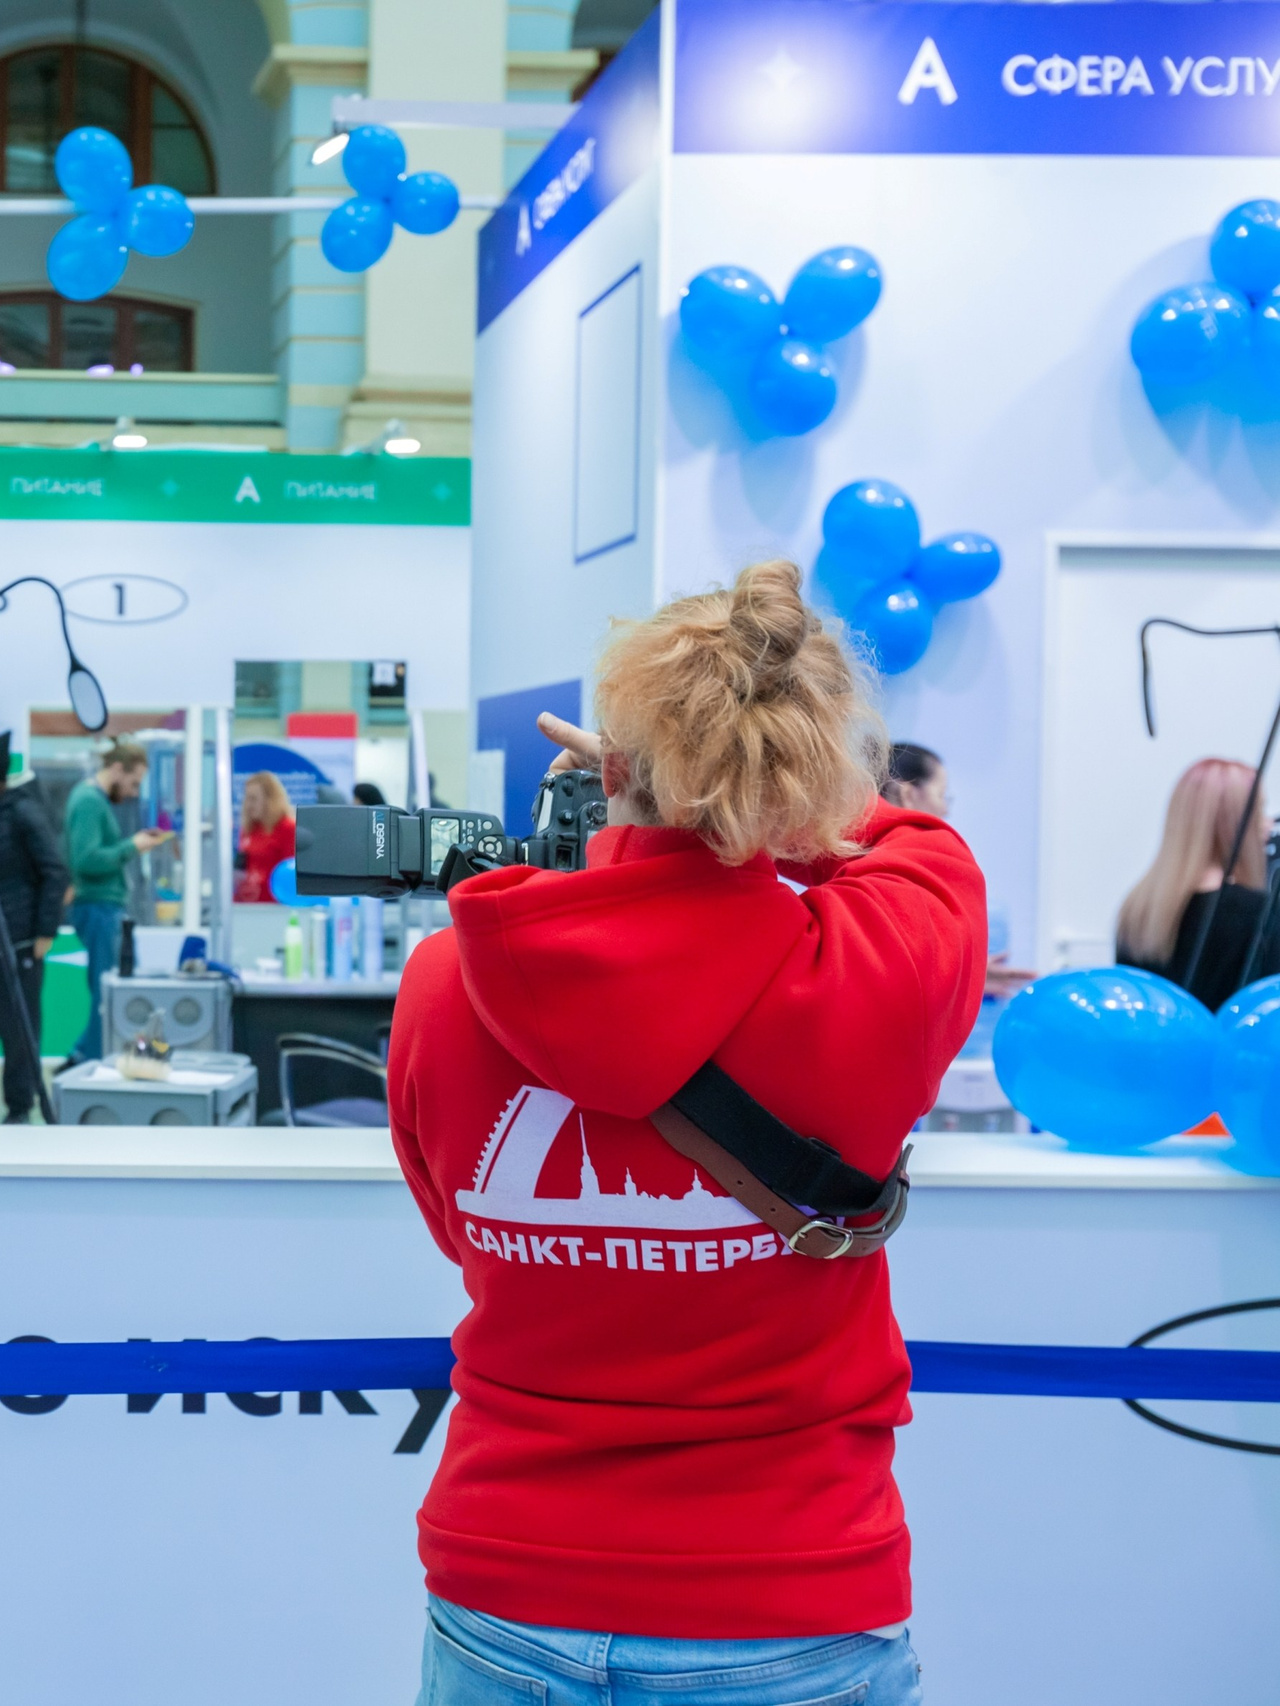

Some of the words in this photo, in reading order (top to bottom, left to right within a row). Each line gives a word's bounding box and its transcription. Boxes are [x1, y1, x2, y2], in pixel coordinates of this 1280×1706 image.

[1000, 53, 1155, 97] СФЕРА
[1161, 55, 1280, 97] УСЛУ
[112, 582, 125, 616] 1
[376, 822, 385, 860] YN560
[464, 1217, 845, 1273] САНКТ-ПЕТЕРБ
